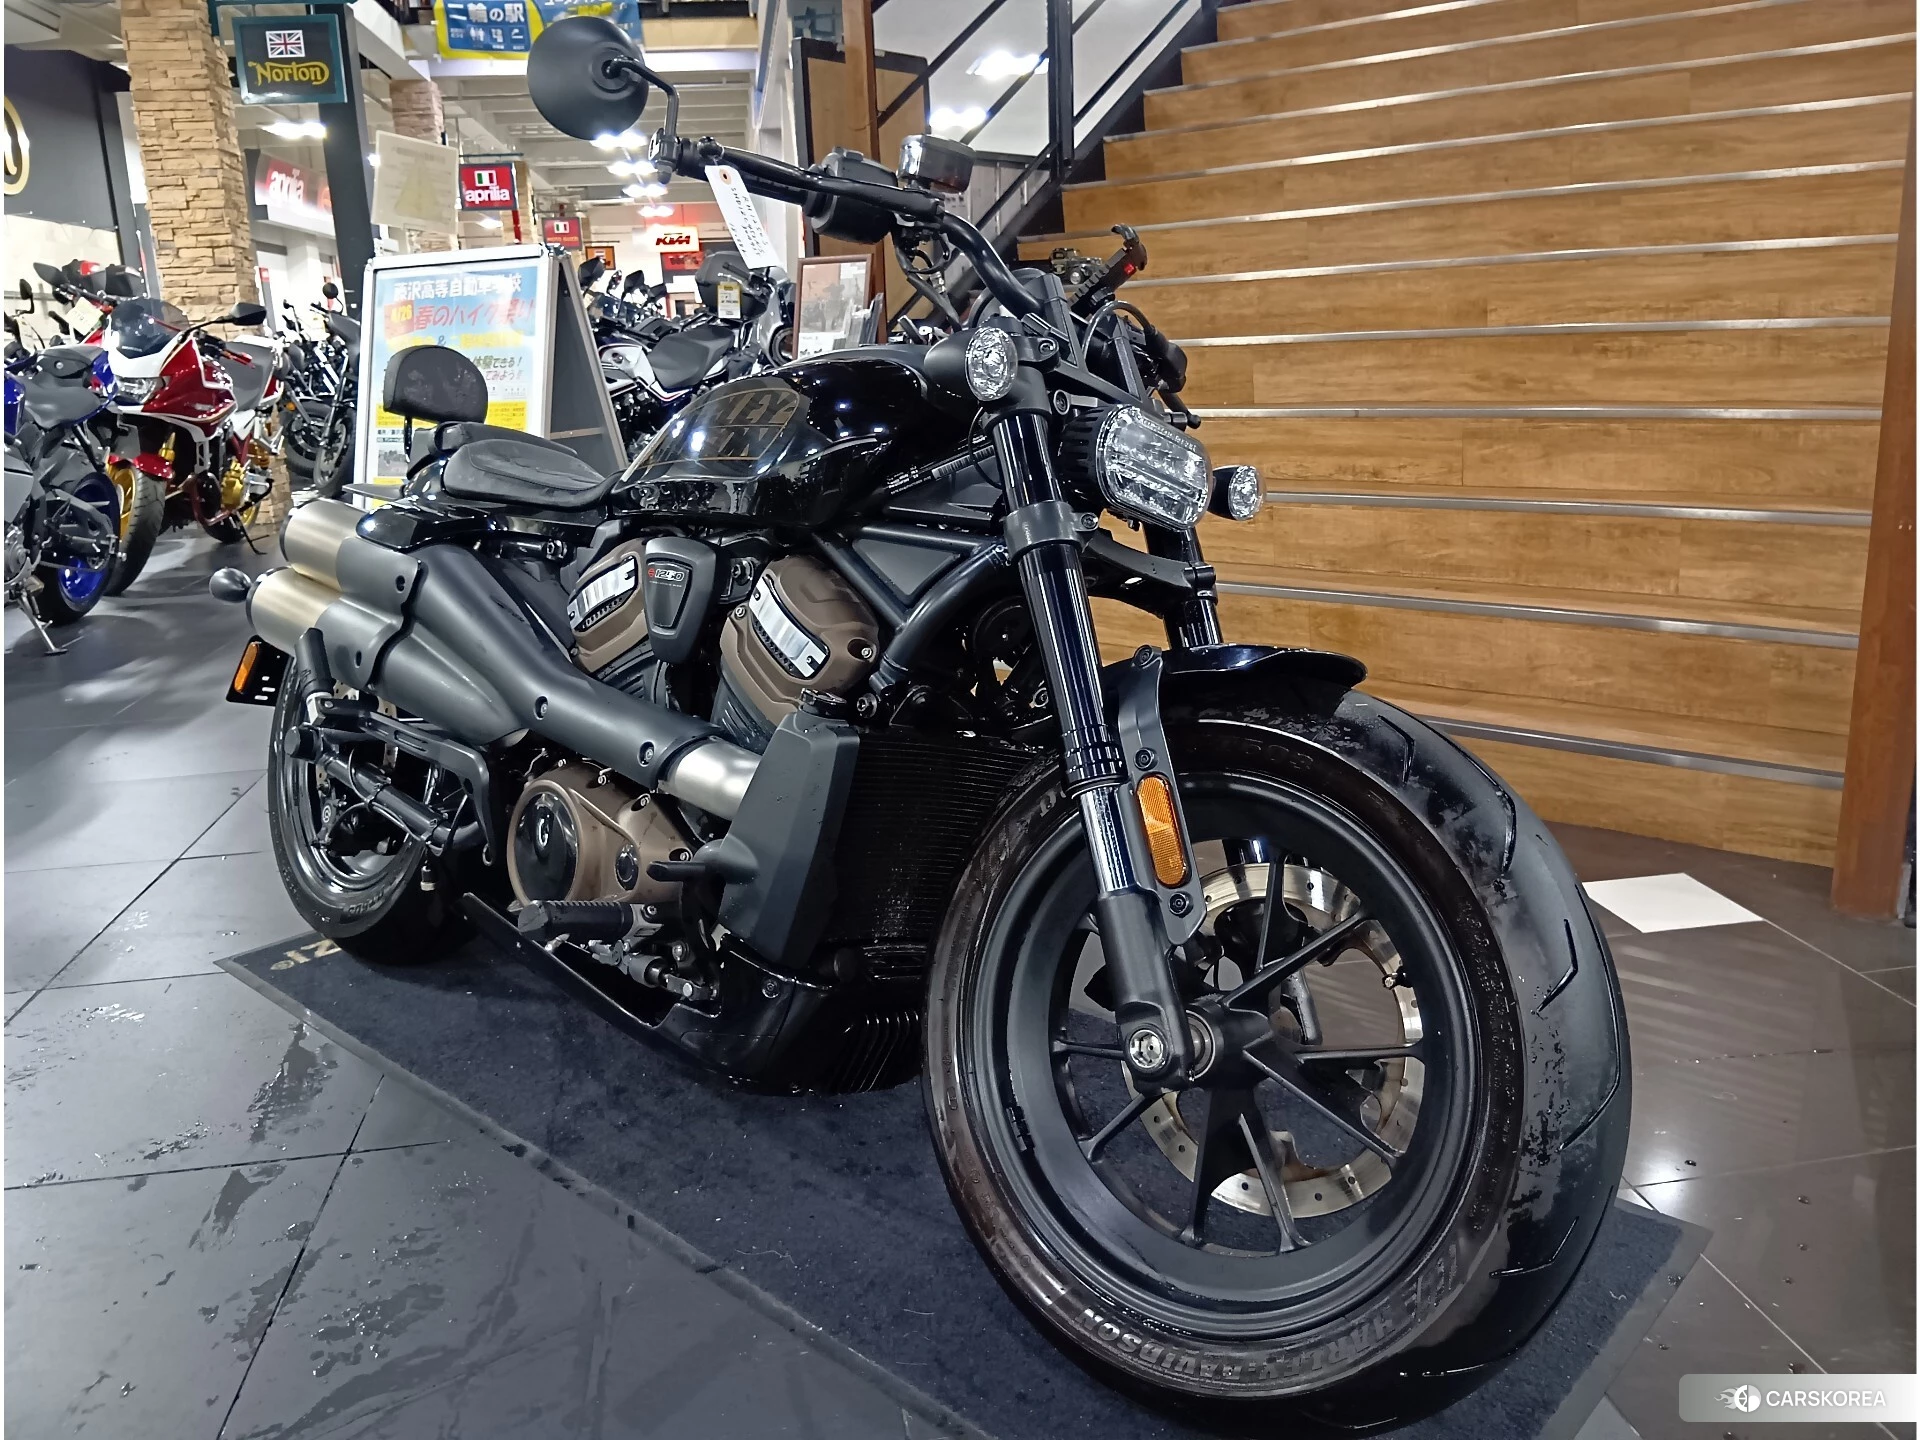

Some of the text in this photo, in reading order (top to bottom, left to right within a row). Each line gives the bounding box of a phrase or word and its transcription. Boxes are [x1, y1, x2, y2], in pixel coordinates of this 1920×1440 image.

[247, 60, 330, 87] Norton
[465, 184, 511, 205] aprilia
[655, 234, 691, 246] KTM
[655, 568, 685, 582] 1250
